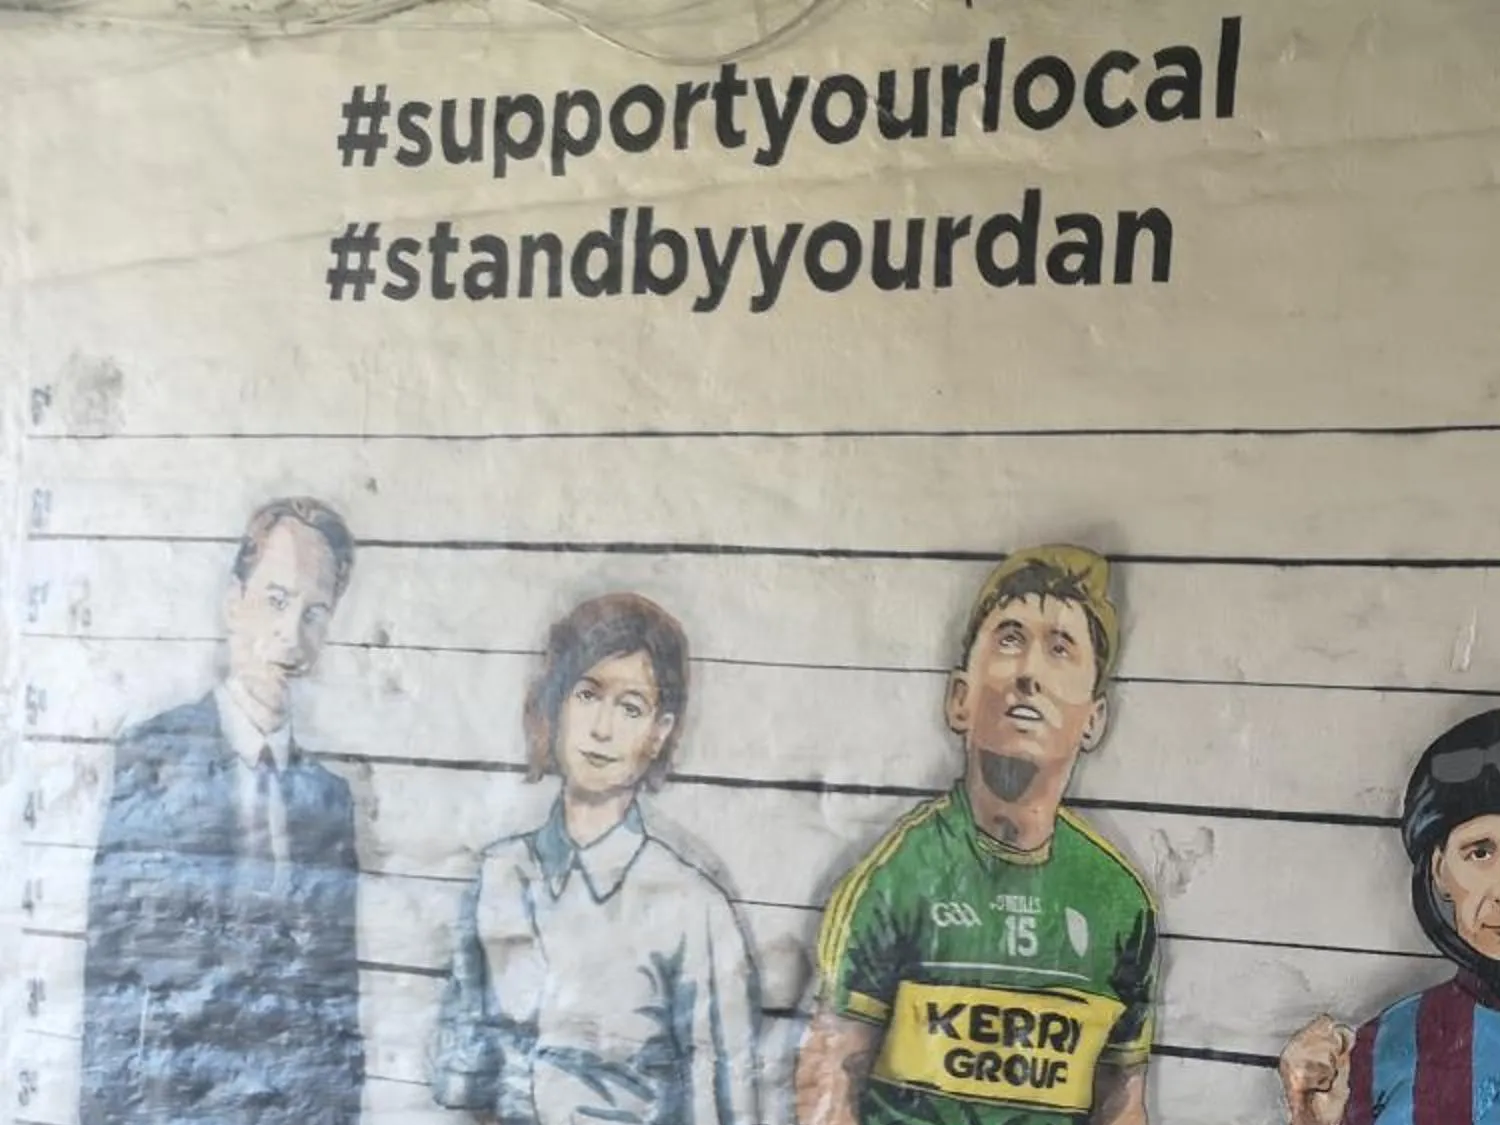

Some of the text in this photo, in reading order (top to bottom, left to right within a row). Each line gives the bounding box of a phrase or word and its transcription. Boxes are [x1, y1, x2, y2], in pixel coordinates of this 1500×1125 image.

[338, 16, 1241, 178] #supportyourlocal
[326, 188, 1174, 313] #standbyyourdan
[1004, 914, 1039, 957] 15
